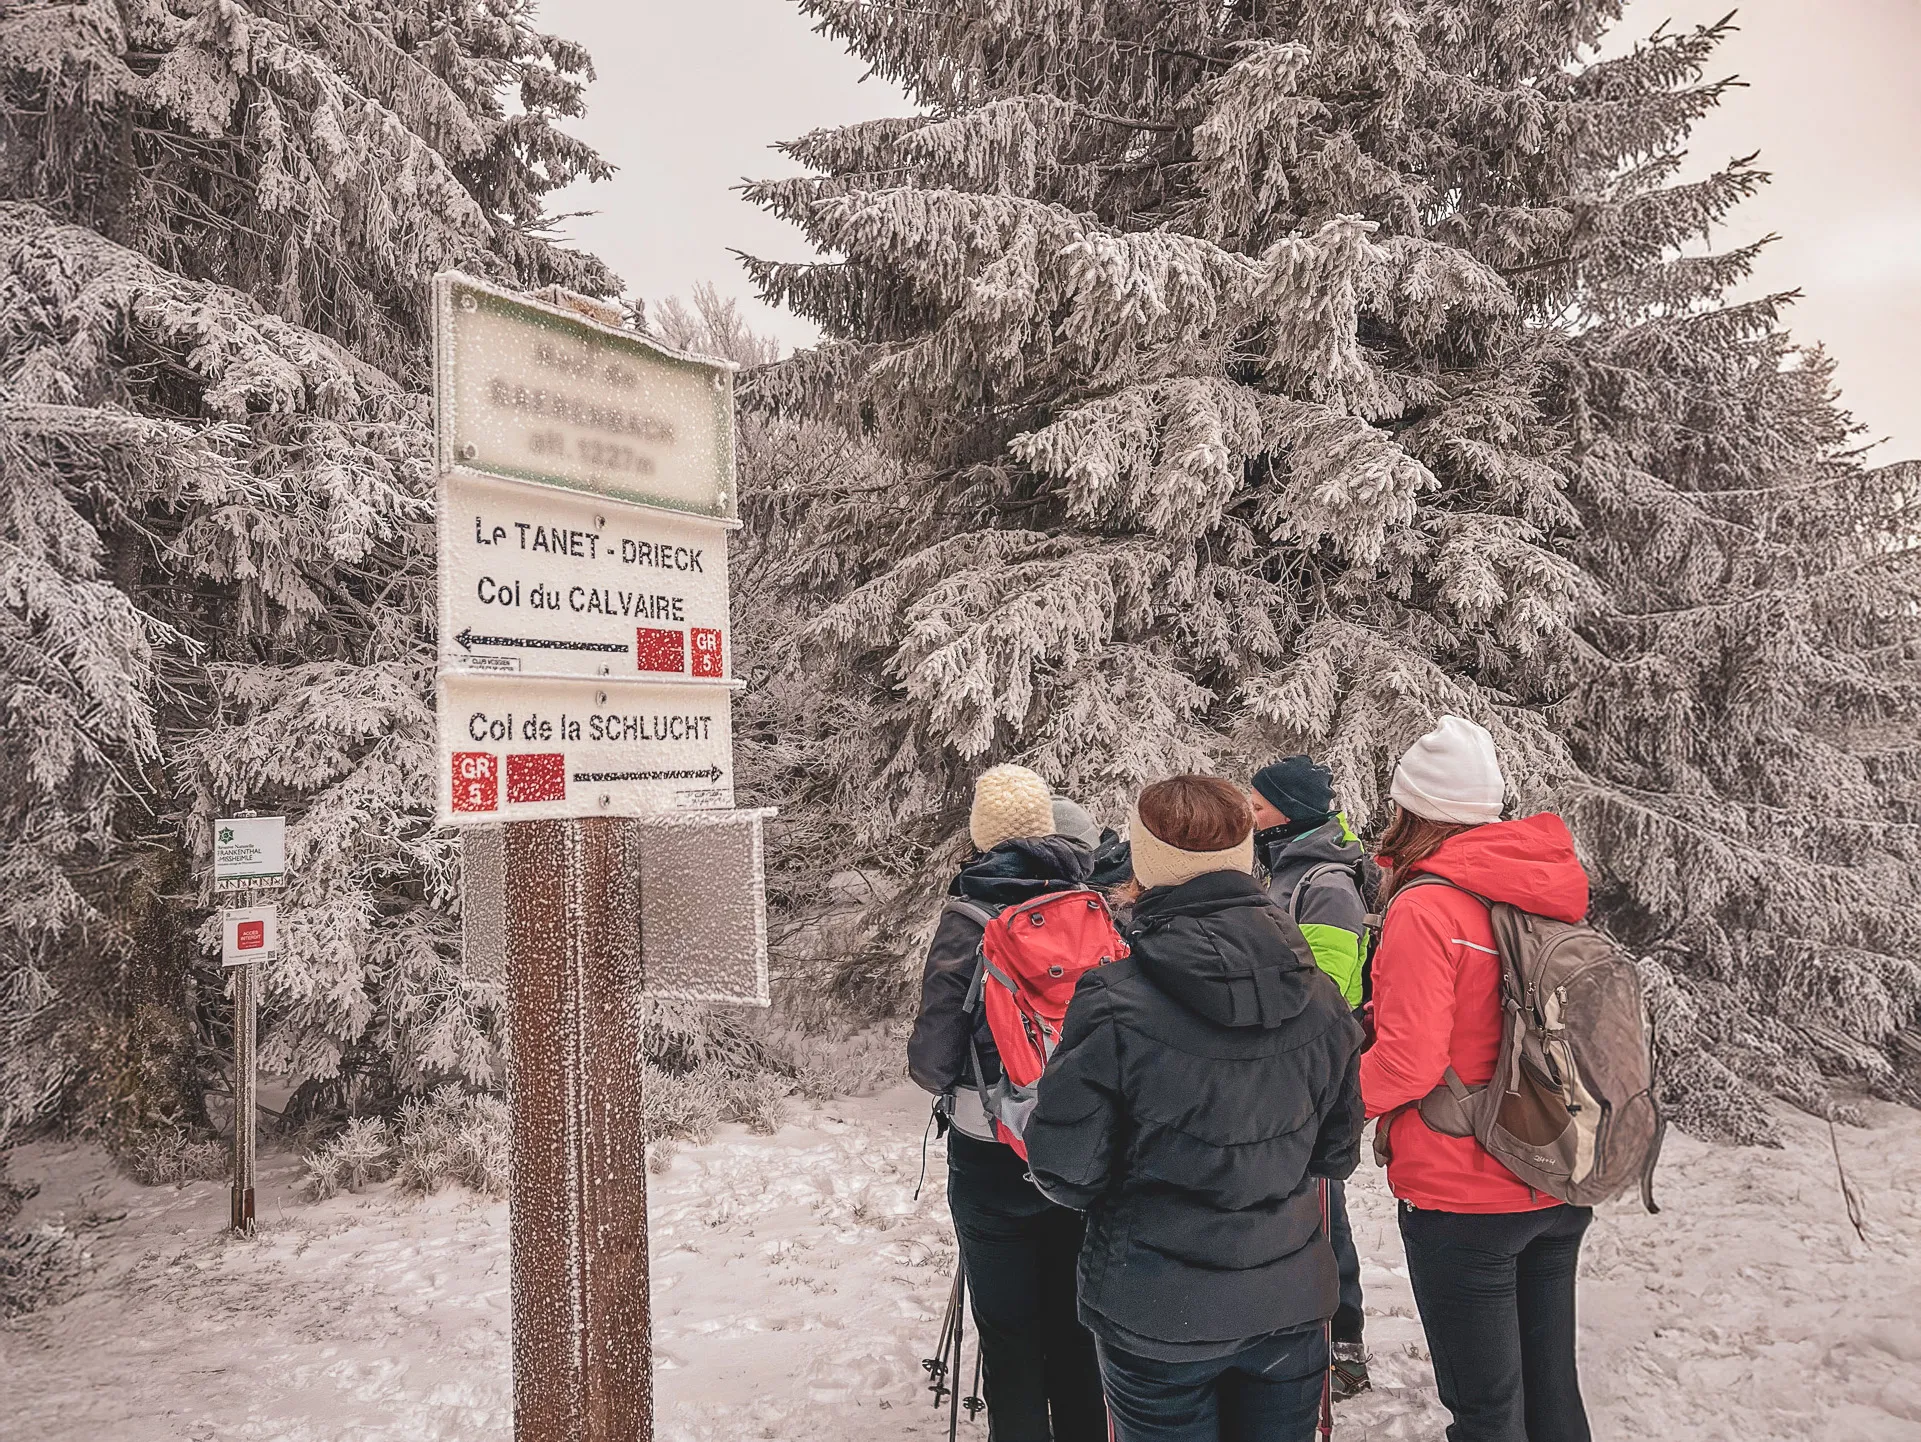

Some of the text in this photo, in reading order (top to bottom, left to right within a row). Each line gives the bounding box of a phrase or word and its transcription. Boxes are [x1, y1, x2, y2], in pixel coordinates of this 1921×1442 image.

[475, 516, 507, 547] Le
[514, 521, 600, 560] TANET
[621, 537, 705, 574] DRIECK
[477, 576, 686, 623] Col du CALVAIRE
[695, 632, 718, 652] GR
[701, 654, 713, 671] 5
[468, 711, 713, 742] Col de la SCHLUCHT
[460, 756, 491, 780] GR
[467, 782, 482, 805] 5
